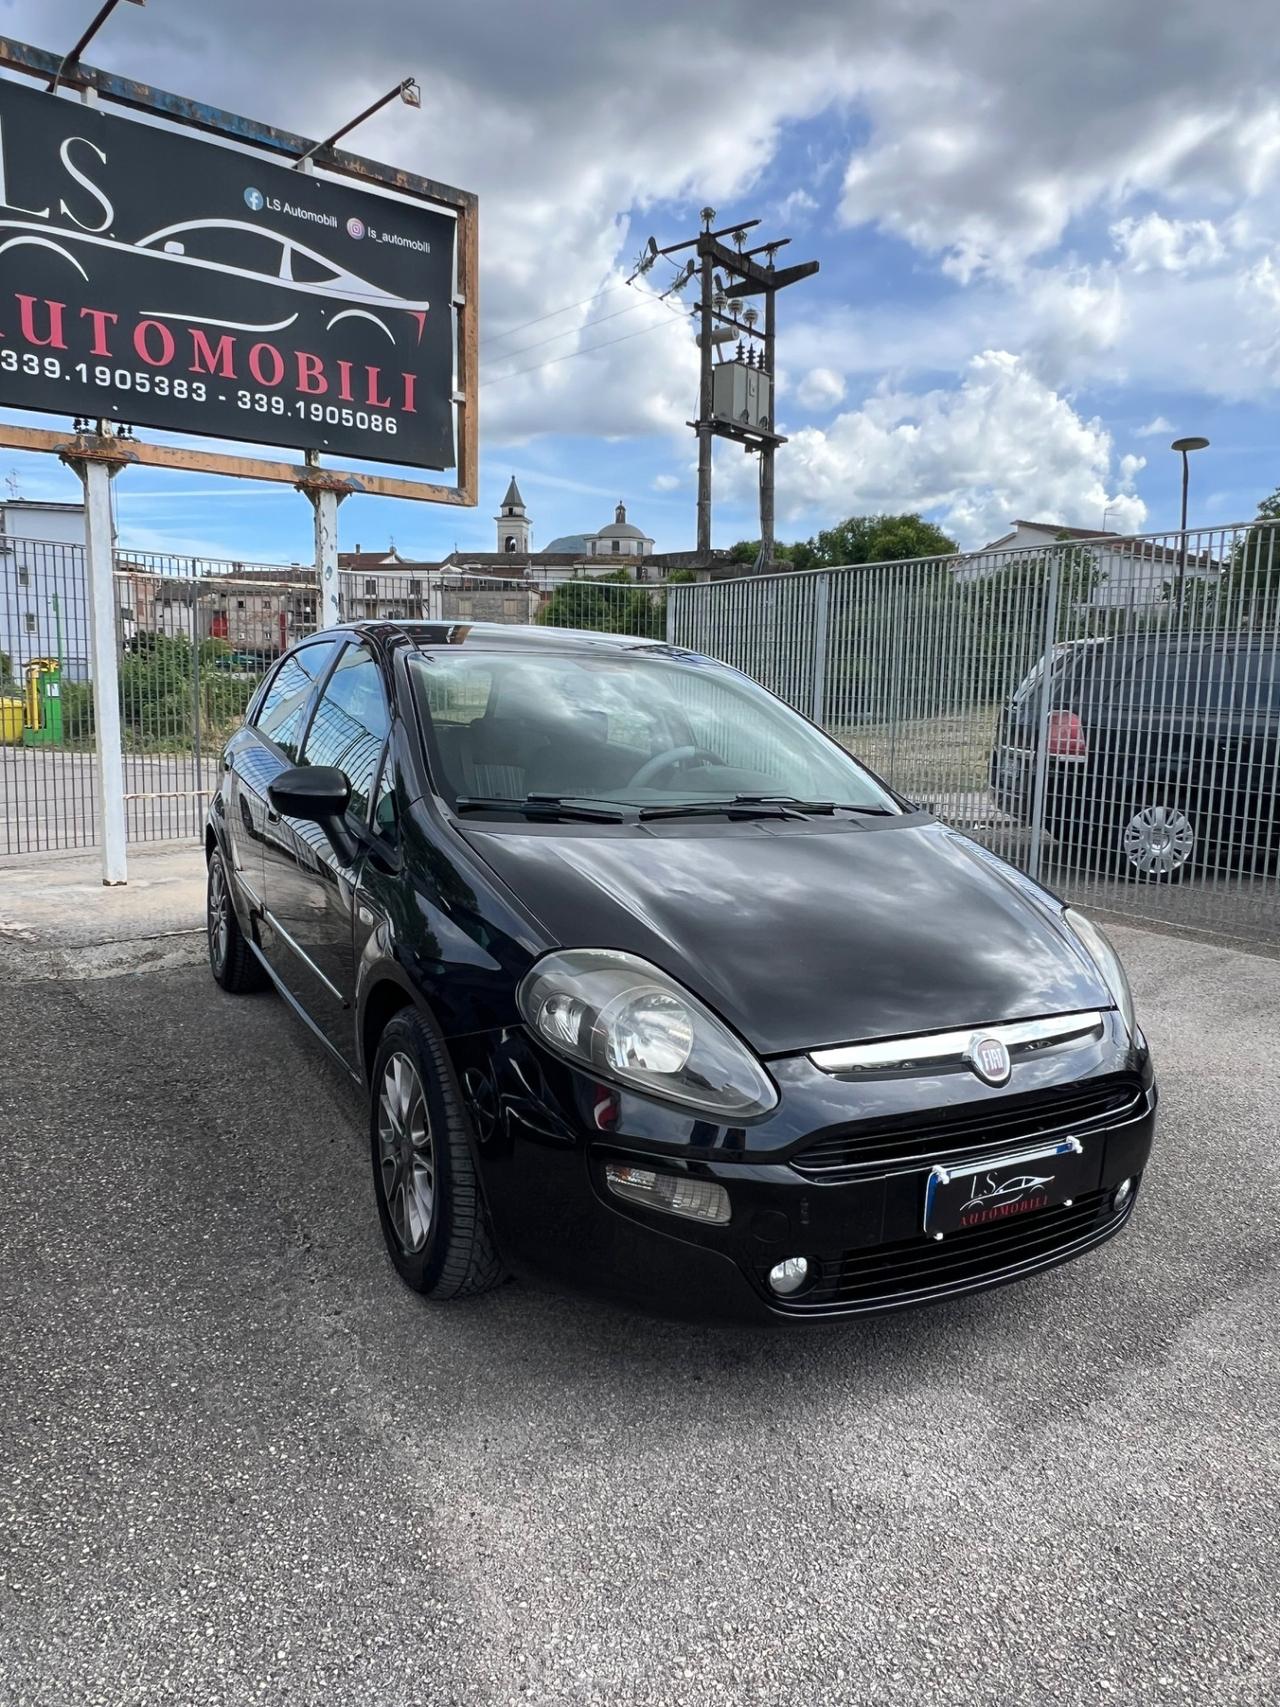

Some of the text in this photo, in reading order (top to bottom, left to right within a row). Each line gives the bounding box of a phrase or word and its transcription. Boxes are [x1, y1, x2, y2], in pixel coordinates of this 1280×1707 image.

[266, 197, 338, 228] LS Automobili
[0, 293, 417, 413] UTOMOBILI
[1, 350, 206, 401] 339.1905383
[237, 390, 397, 435] 339.1905086
[981, 1048, 1004, 1071] FIAT
[960, 1195, 1048, 1226] AUTOMOBILI
